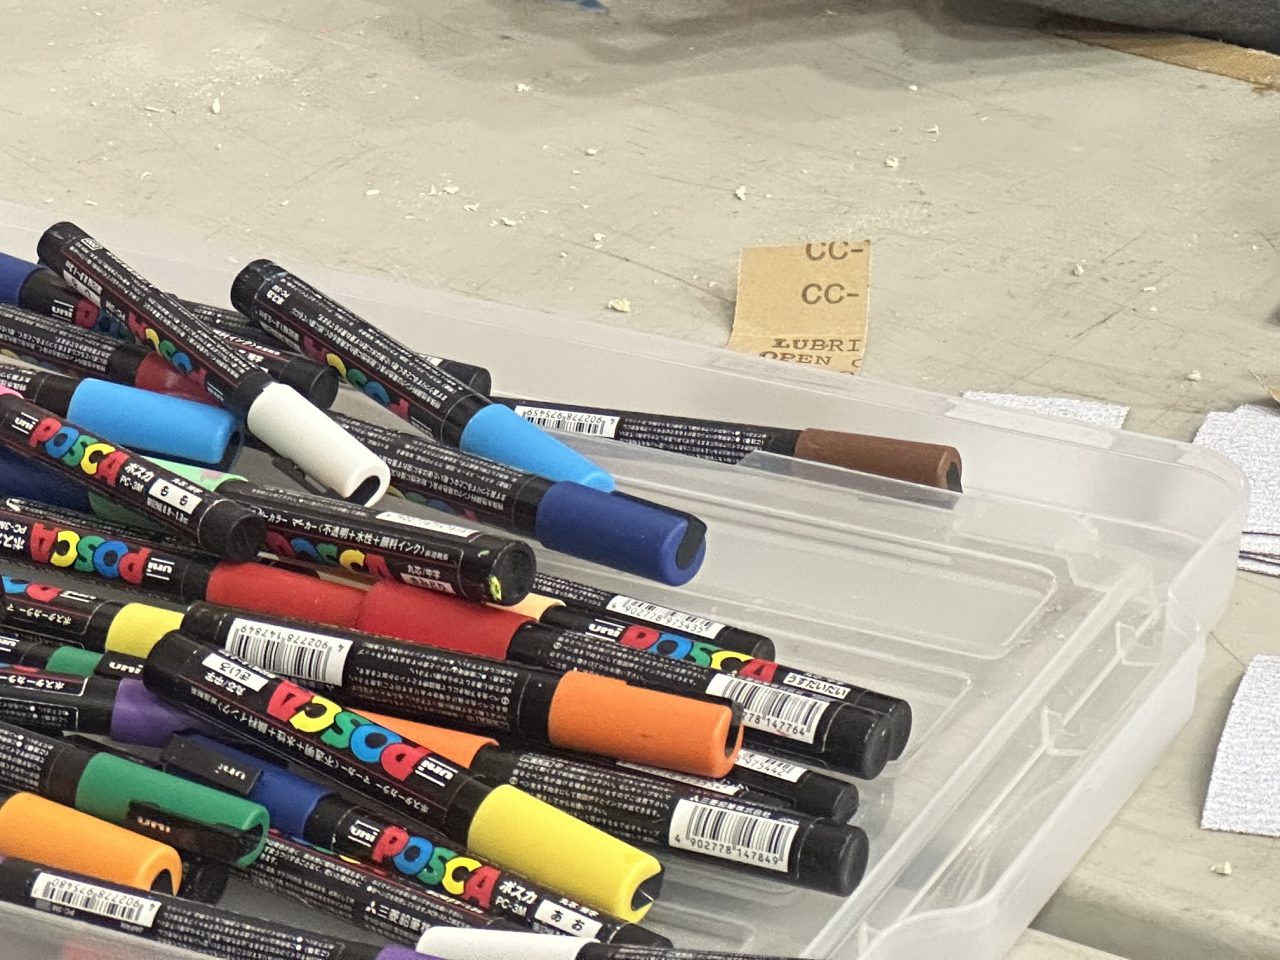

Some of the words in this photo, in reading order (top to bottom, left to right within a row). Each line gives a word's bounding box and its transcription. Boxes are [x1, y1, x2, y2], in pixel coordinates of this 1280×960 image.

[805, 240, 863, 261] CC-
[801, 283, 859, 304] CC-
[772, 338, 862, 352] LUBRI
[566, 412, 602, 424] 902778
[14, 414, 35, 432] uni
[29, 417, 129, 487] POSCA
[119, 475, 145, 492] PC-3M
[0, 533, 25, 549] ポス
[30, 523, 151, 584] POSCA
[146, 561, 173, 574] uni
[625, 606, 662, 621] 902778
[666, 614, 703, 633] 975435
[239, 623, 282, 639] 147849
[286, 633, 328, 648] 902778
[587, 621, 621, 639] uni
[619, 624, 779, 682] POSCA
[109, 661, 144, 674] uni
[220, 662, 252, 681] きいろ
[204, 673, 247, 697] 丸芯/中字
[267, 680, 431, 781] POSCA
[766, 715, 805, 736] 147764
[418, 757, 455, 784] uni
[374, 780, 429, 814] ポスターカラー
[137, 816, 171, 833] uni
[688, 836, 732, 855] 902778
[736, 847, 779, 866] 147849
[372, 826, 500, 910] POSCA
[50, 876, 94, 896] 975480
[500, 880, 538, 904] ポスカ
[97, 889, 140, 908] 902778
[495, 896, 528, 917] PC-3M
[550, 909, 584, 931] あお
